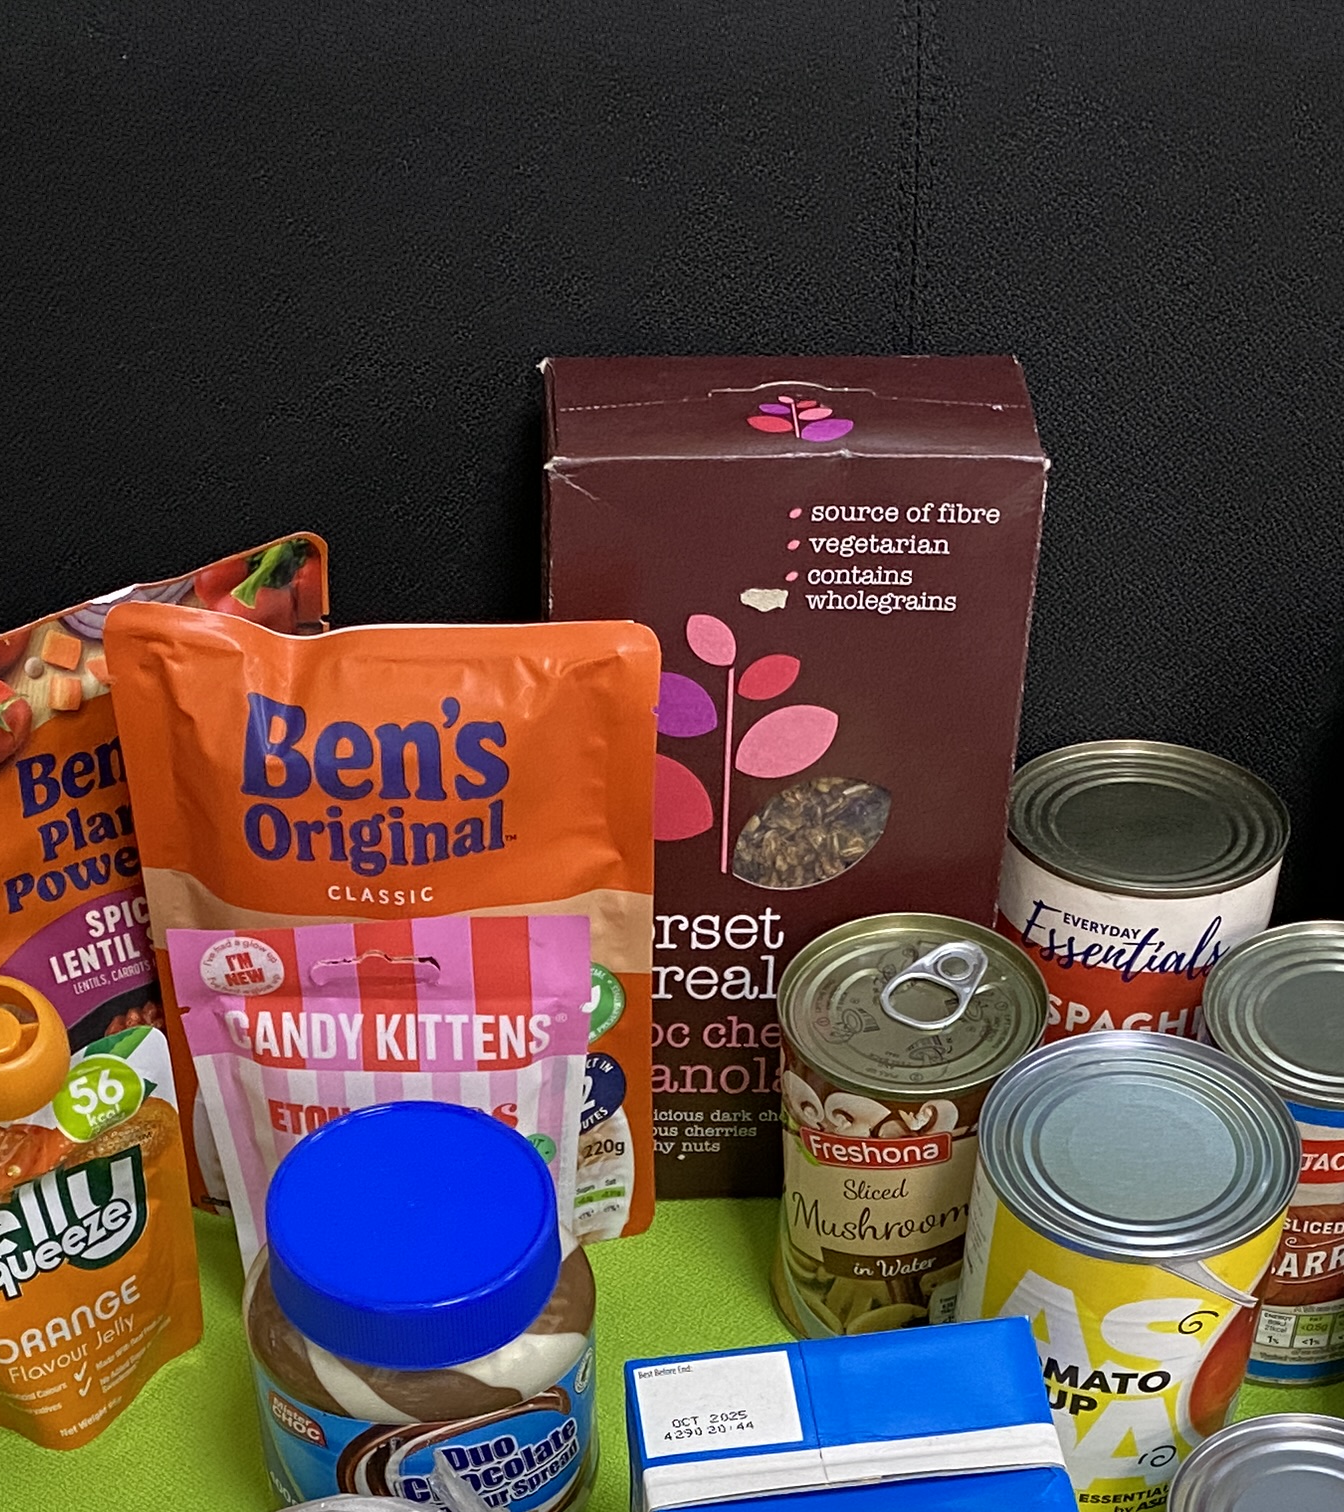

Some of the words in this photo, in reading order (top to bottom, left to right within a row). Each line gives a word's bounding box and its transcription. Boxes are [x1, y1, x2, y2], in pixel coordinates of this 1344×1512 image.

[810, 505, 898, 524] source
[906, 503, 932, 523] of
[937, 503, 1000, 524] fibre
[809, 536, 950, 557] vegetarian
[807, 566, 913, 585] contains
[807, 589, 957, 612] wholegrains
[241, 692, 510, 800] Ben's
[244, 800, 505, 877] Original
[328, 886, 435, 905] CLASSIC
[1063, 911, 1142, 942] EVERYDAY
[1021, 899, 1230, 983] Essentials
[49, 931, 141, 985] LENTIL
[225, 952, 253, 971] I'M
[224, 968, 265, 986] NEW
[226, 1010, 364, 1062] CANDY
[376, 1011, 551, 1061] KITTENS
[67, 1069, 125, 1115] 56
[86, 1103, 121, 1127] kcal
[711, 1109, 752, 1122] dark
[684, 1124, 757, 1137] cherries
[584, 1139, 625, 1158] 220g
[681, 1140, 721, 1153] nuts
[810, 1136, 940, 1164] Freshona
[843, 1178, 909, 1201] Sliced
[853, 1264, 874, 1277] in
[877, 1256, 937, 1278] Water
[8, 1341, 89, 1384] Flavour
[94, 1313, 136, 1352] Jelly
[272, 1405, 320, 1441] CHOC
[672, 1415, 699, 1429] OCT
[710, 1410, 748, 1424] 2025
